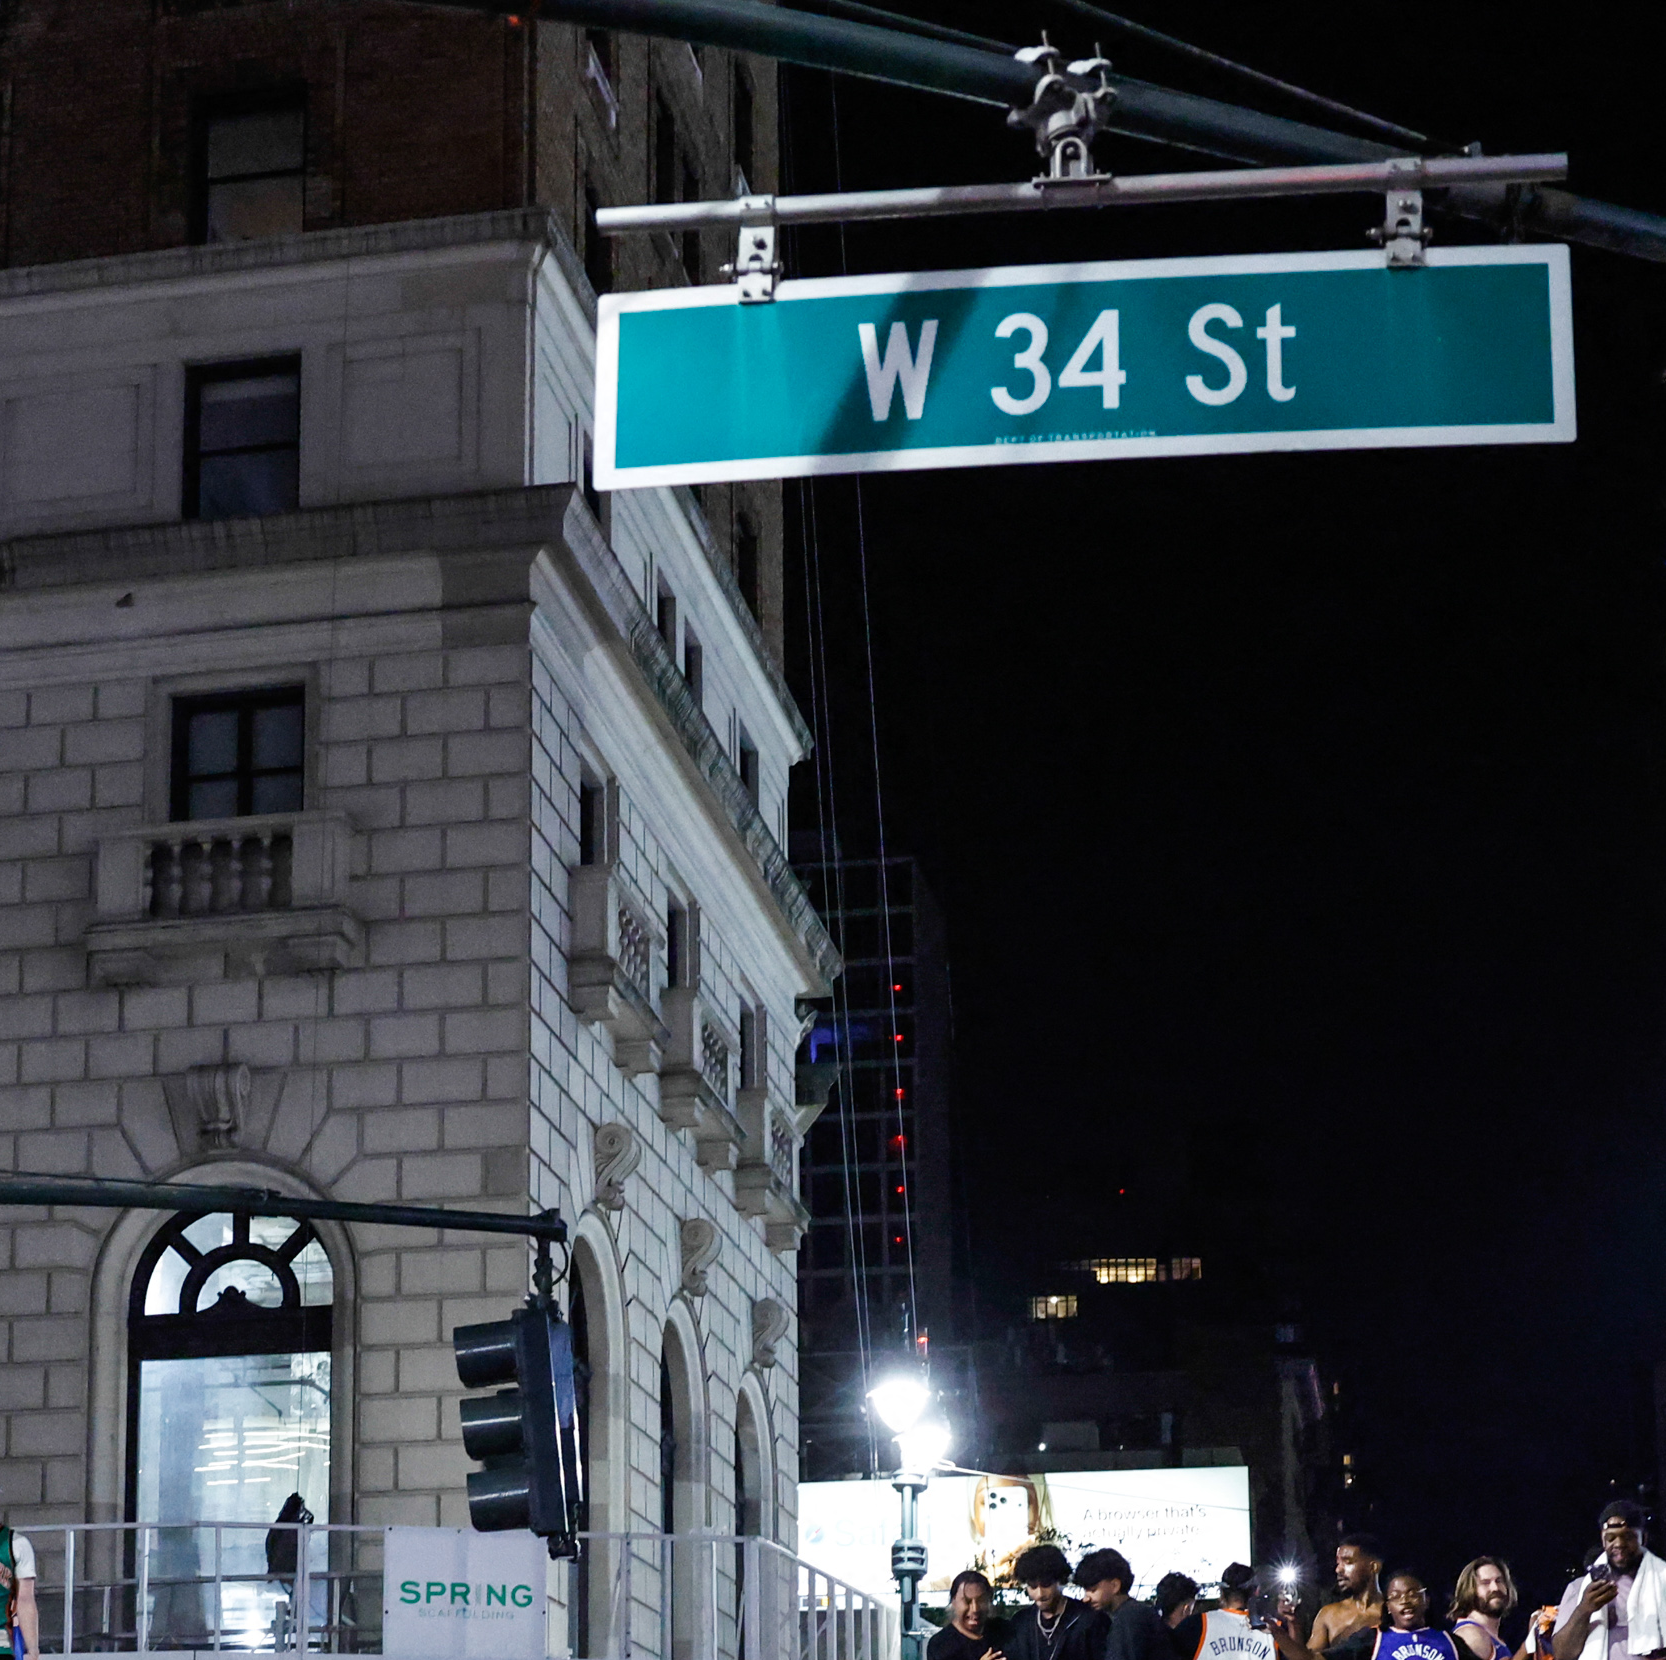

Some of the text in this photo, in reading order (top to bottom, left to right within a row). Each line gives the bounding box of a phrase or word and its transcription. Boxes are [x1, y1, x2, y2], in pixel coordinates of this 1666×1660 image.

[857, 302, 1297, 422] W 34 St
[1083, 1503, 1207, 1522] A browser that's
[834, 1514, 932, 1547] Safi
[1082, 1525, 1143, 1540] actually
[399, 1580, 533, 1608] SPRING
[418, 1606, 515, 1620] SCAFFOLDING
[1209, 1636, 1272, 1660] BRUNSON
